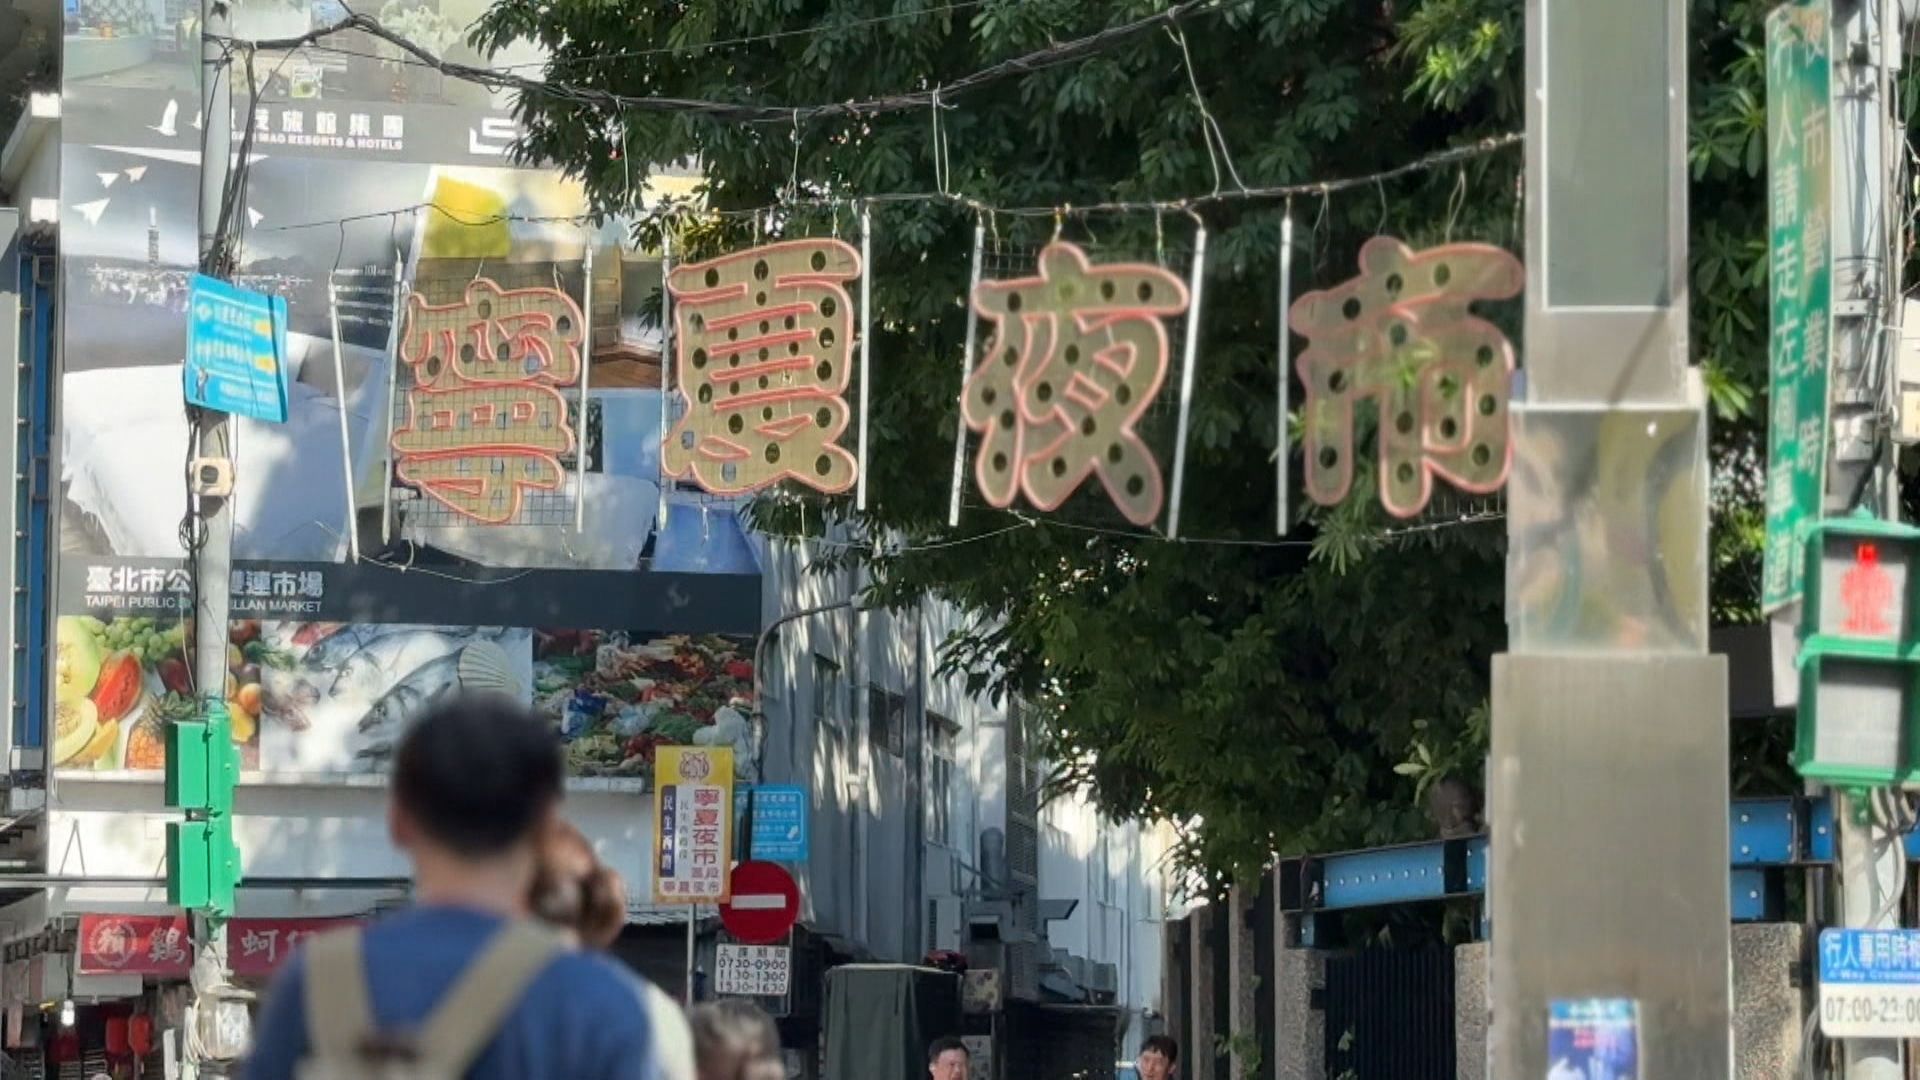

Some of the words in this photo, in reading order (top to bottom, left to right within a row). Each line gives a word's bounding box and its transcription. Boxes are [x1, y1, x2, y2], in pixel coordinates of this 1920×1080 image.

[288, 135, 343, 148] RESORTS
[358, 139, 403, 150] HOTELS
[391, 237, 1526, 527] 寧夏夜市
[85, 595, 125, 608] TAIPEI
[128, 597, 176, 610] PUBLIC
[269, 600, 322, 613] MARKET
[692, 788, 720, 865] 寧夏夜市
[718, 956, 787, 970] 0730-0900
[719, 968, 786, 982] 1130-1300
[719, 980, 785, 993] 1530-1630
